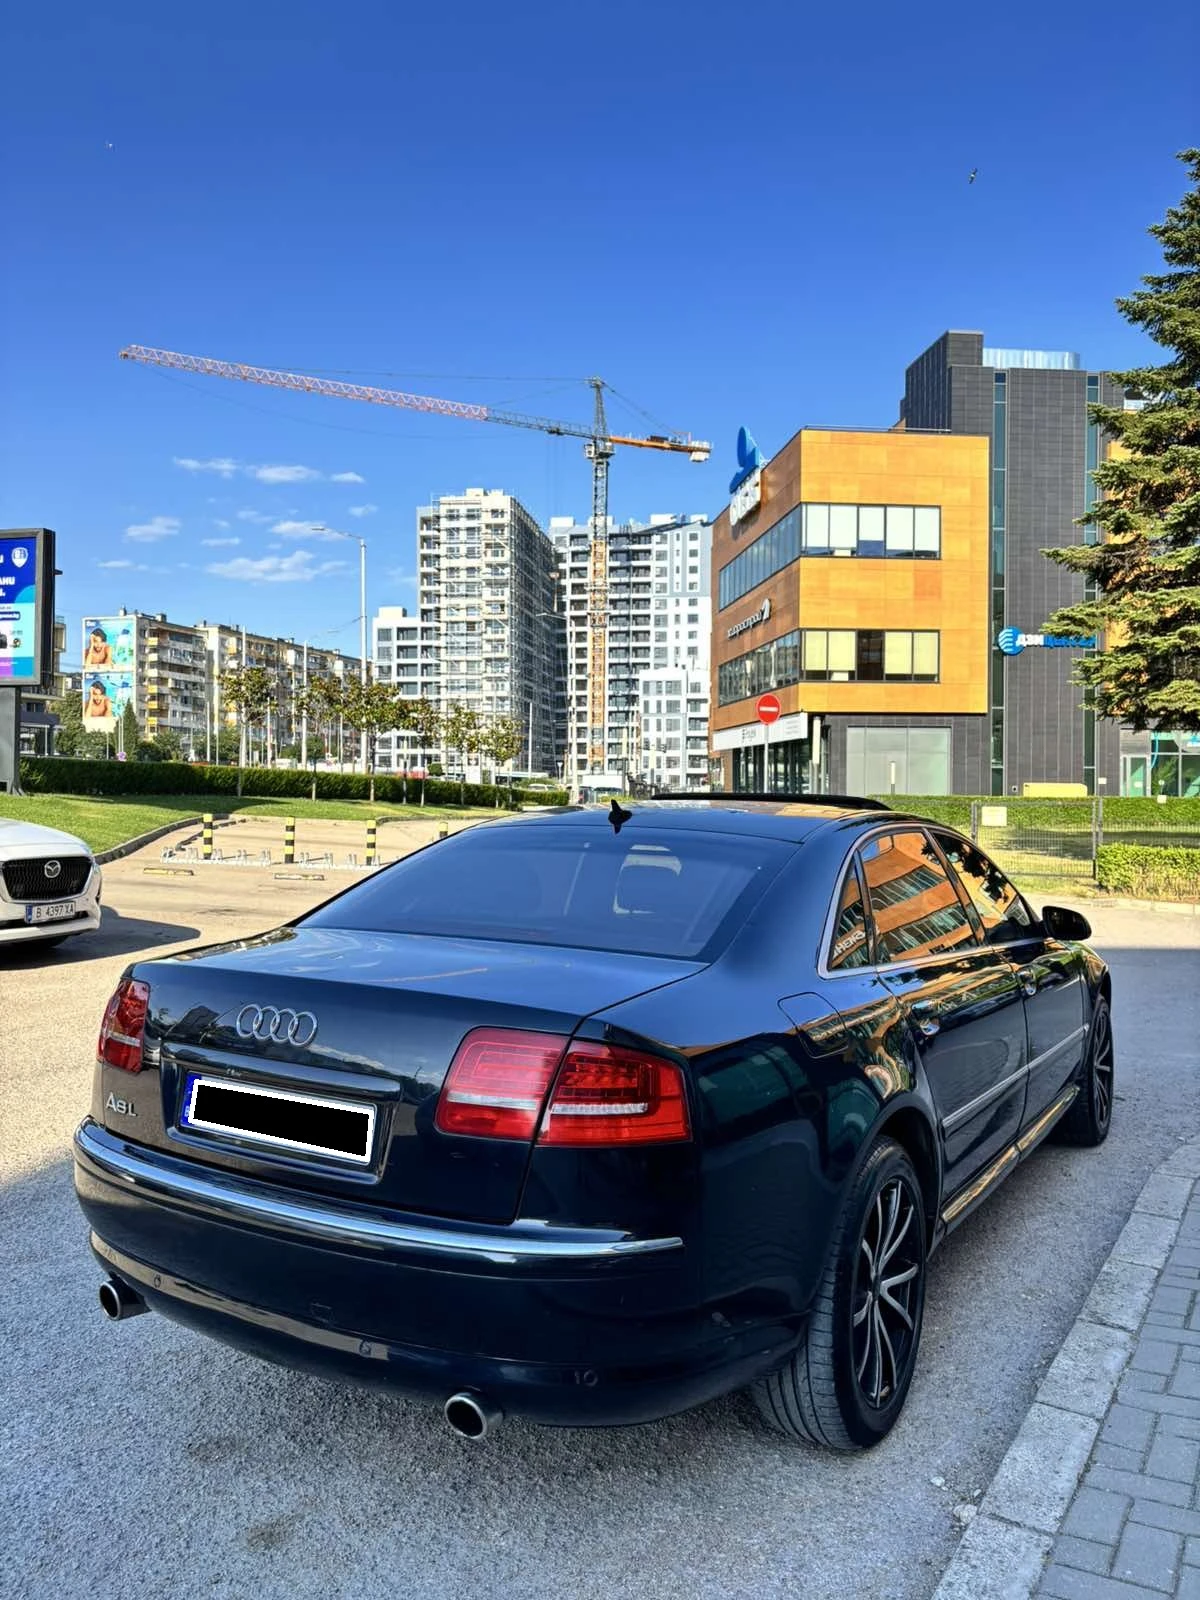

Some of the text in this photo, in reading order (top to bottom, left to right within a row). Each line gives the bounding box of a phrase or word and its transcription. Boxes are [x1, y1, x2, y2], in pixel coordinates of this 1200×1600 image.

[36, 907, 42, 918] B
[46, 904, 64, 917] 4397
[105, 1091, 137, 1117] A8L
